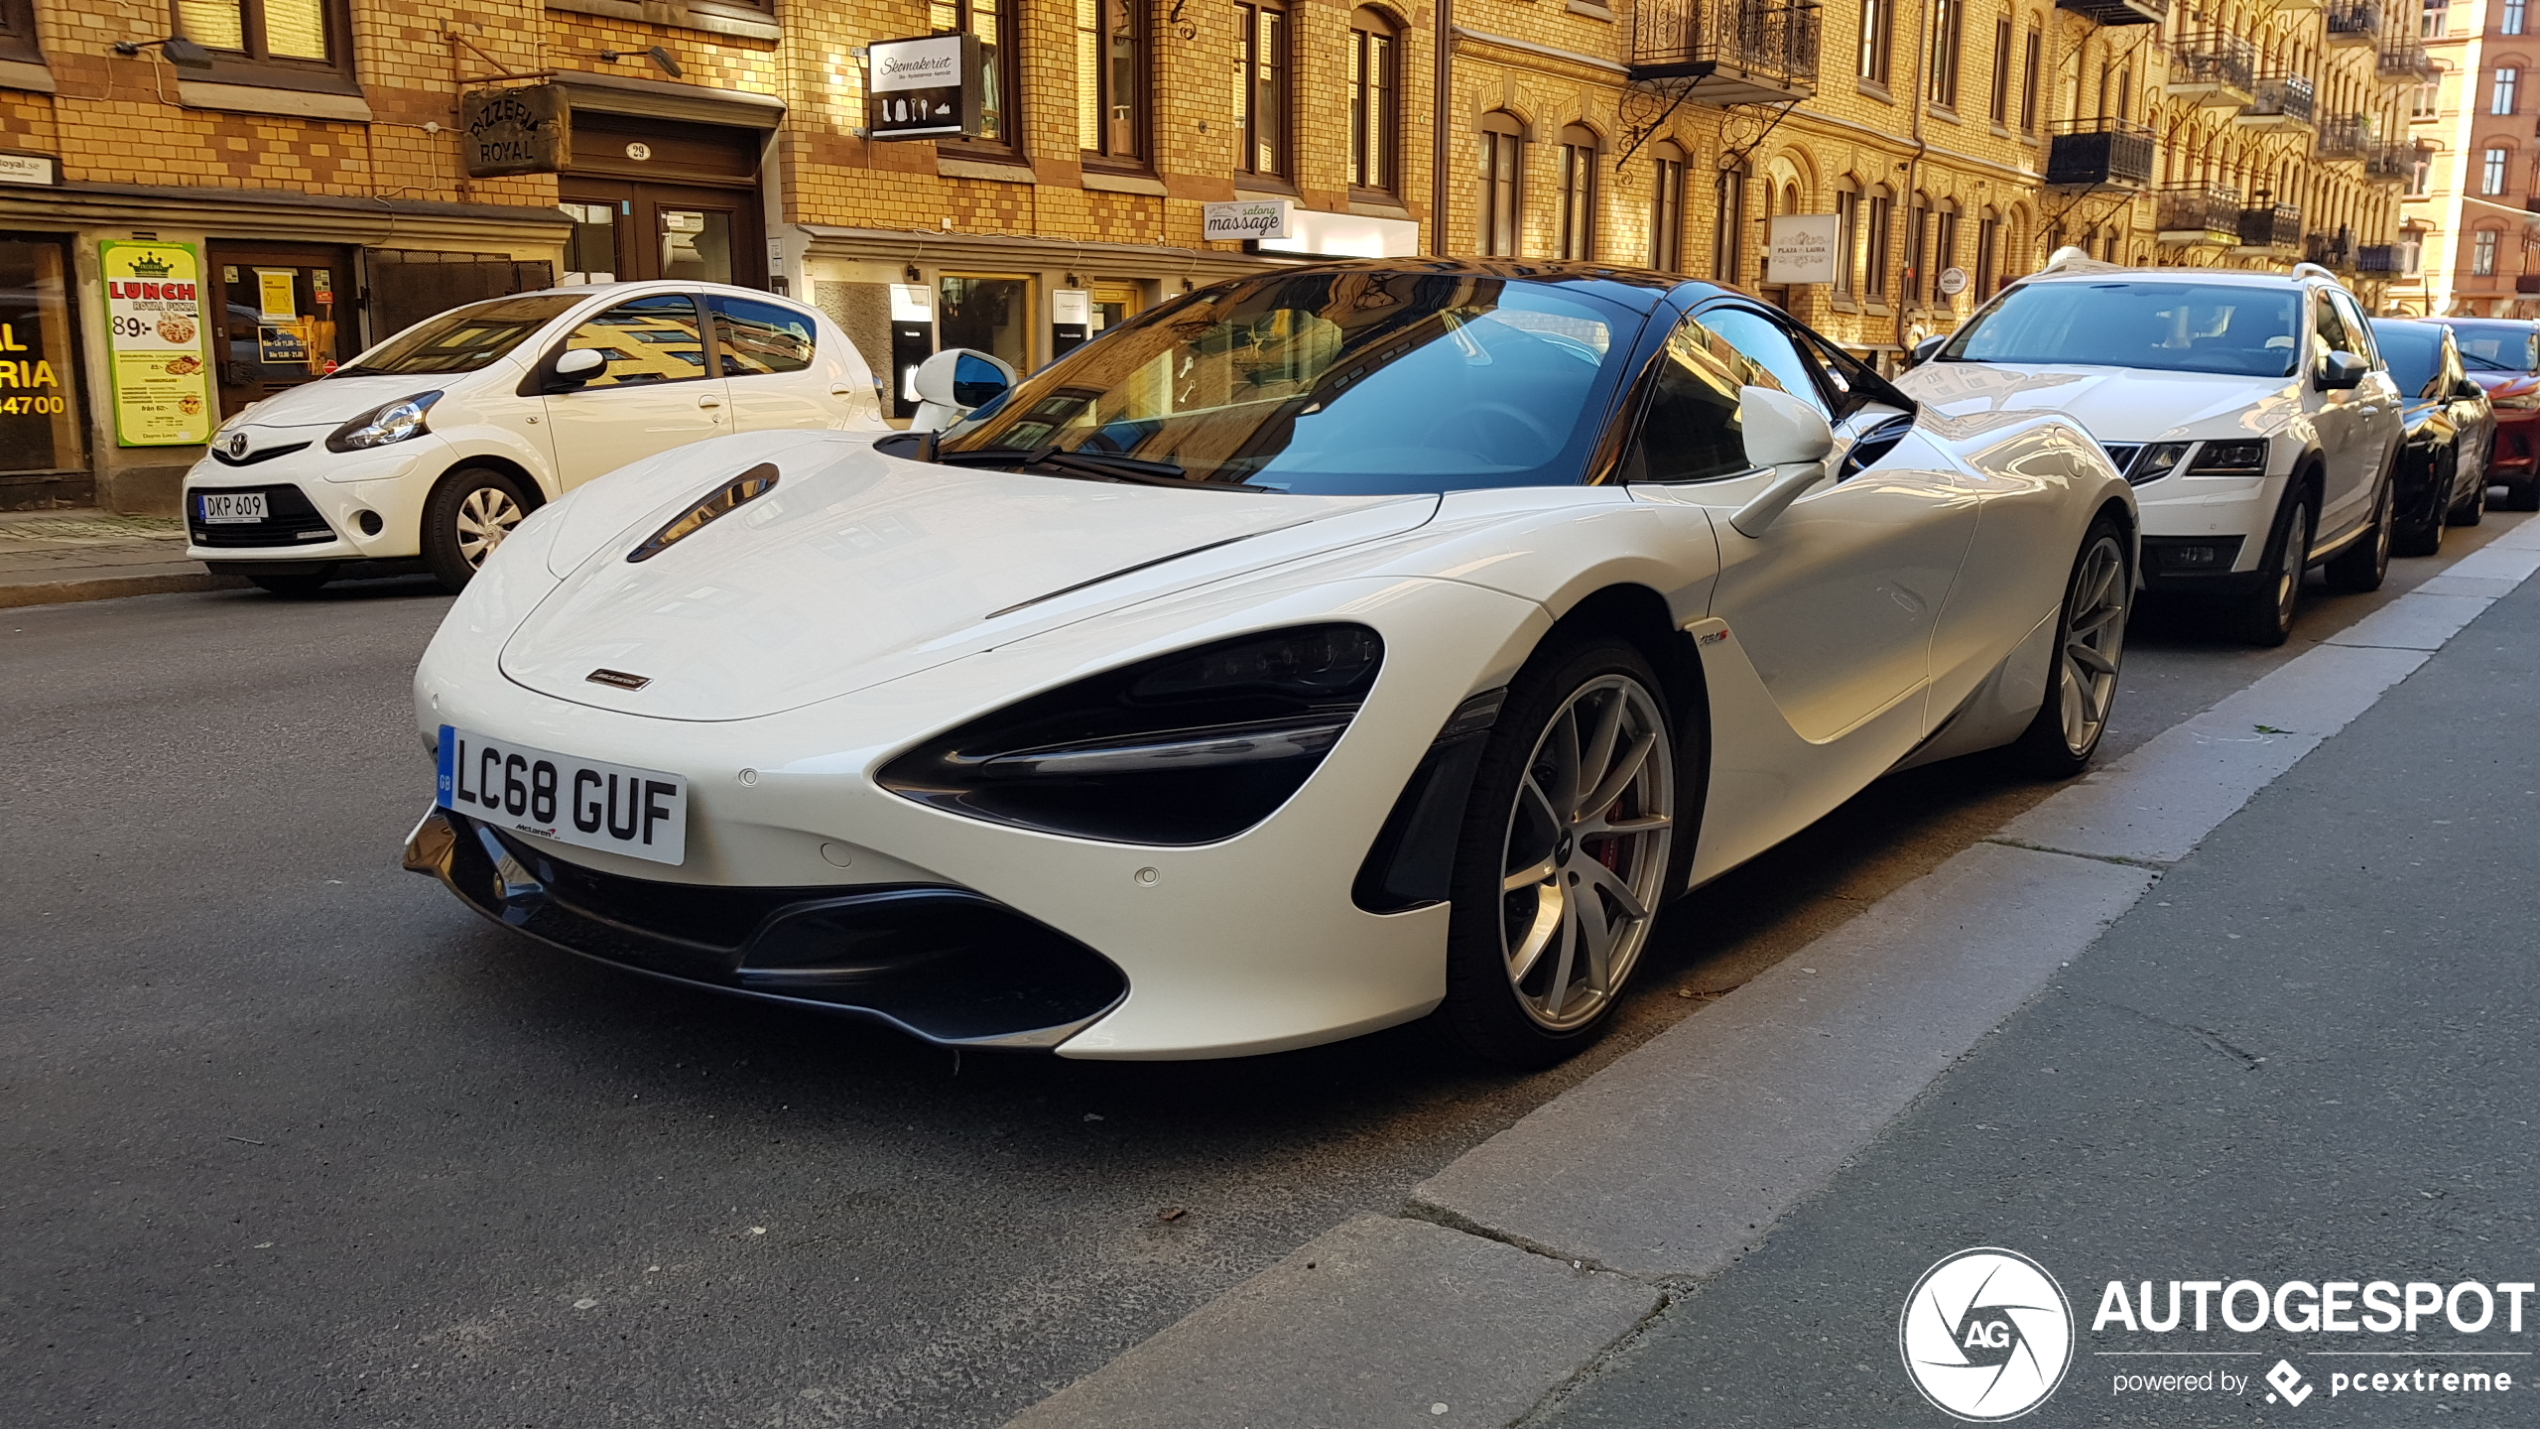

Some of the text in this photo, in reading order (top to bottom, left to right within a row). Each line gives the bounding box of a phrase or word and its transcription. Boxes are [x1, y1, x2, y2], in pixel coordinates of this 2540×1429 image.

[880, 56, 951, 76] Skomakeriet
[469, 99, 540, 138] PIZZERIA
[480, 141, 534, 163] ROYAL
[632, 145, 645, 158] 29
[1242, 205, 1276, 217] salong
[1208, 216, 1280, 236] massage
[109, 281, 197, 300] LUNCH
[133, 301, 197, 312] ROYAL PIZZA
[0, 323, 28, 351] L
[207, 496, 261, 516] DKP 609
[440, 774, 451, 792] GB
[457, 739, 677, 845] LC68 GUF
[515, 823, 552, 838] McLaren
